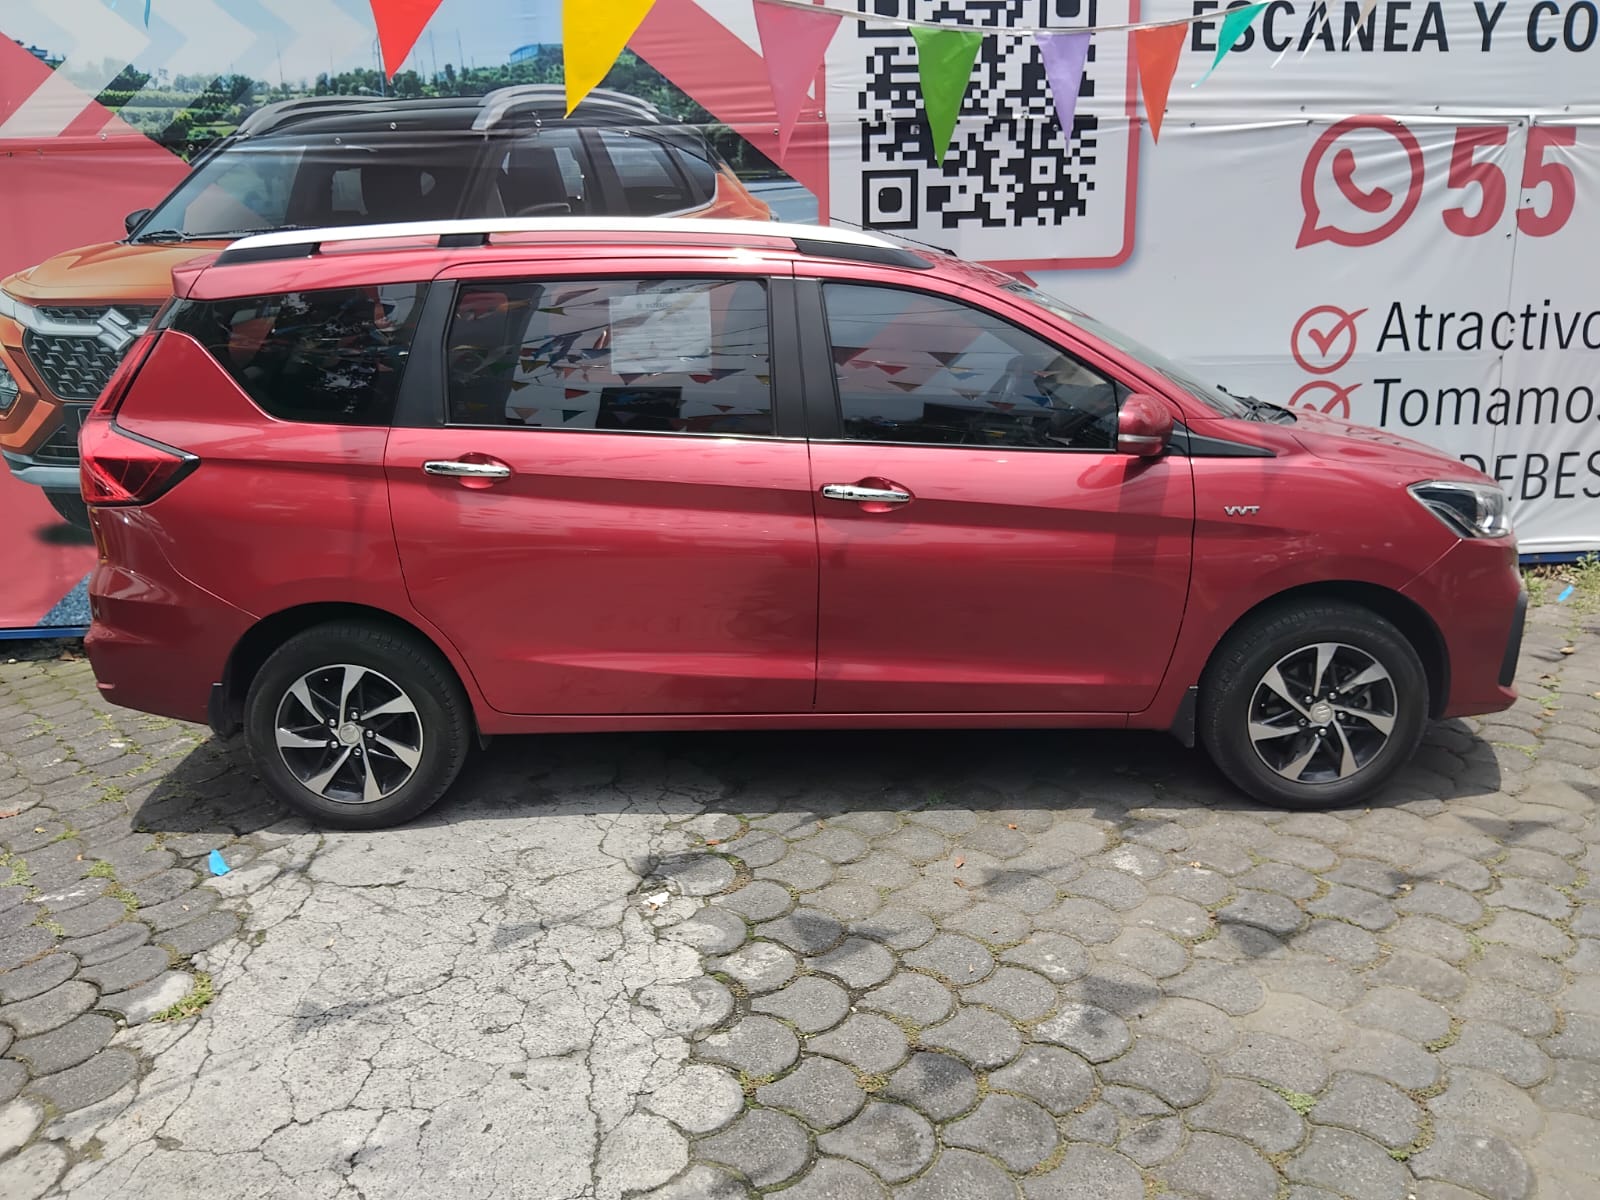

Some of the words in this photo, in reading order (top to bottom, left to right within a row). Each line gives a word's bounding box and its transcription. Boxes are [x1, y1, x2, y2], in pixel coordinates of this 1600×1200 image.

[1474, 1, 1507, 53] Y
[1526, 0, 1599, 53] CO
[1442, 126, 1577, 237] 55
[1376, 299, 1600, 352] Atractivo
[1373, 378, 1600, 428] Tomamo
[1224, 505, 1260, 516] VVT
